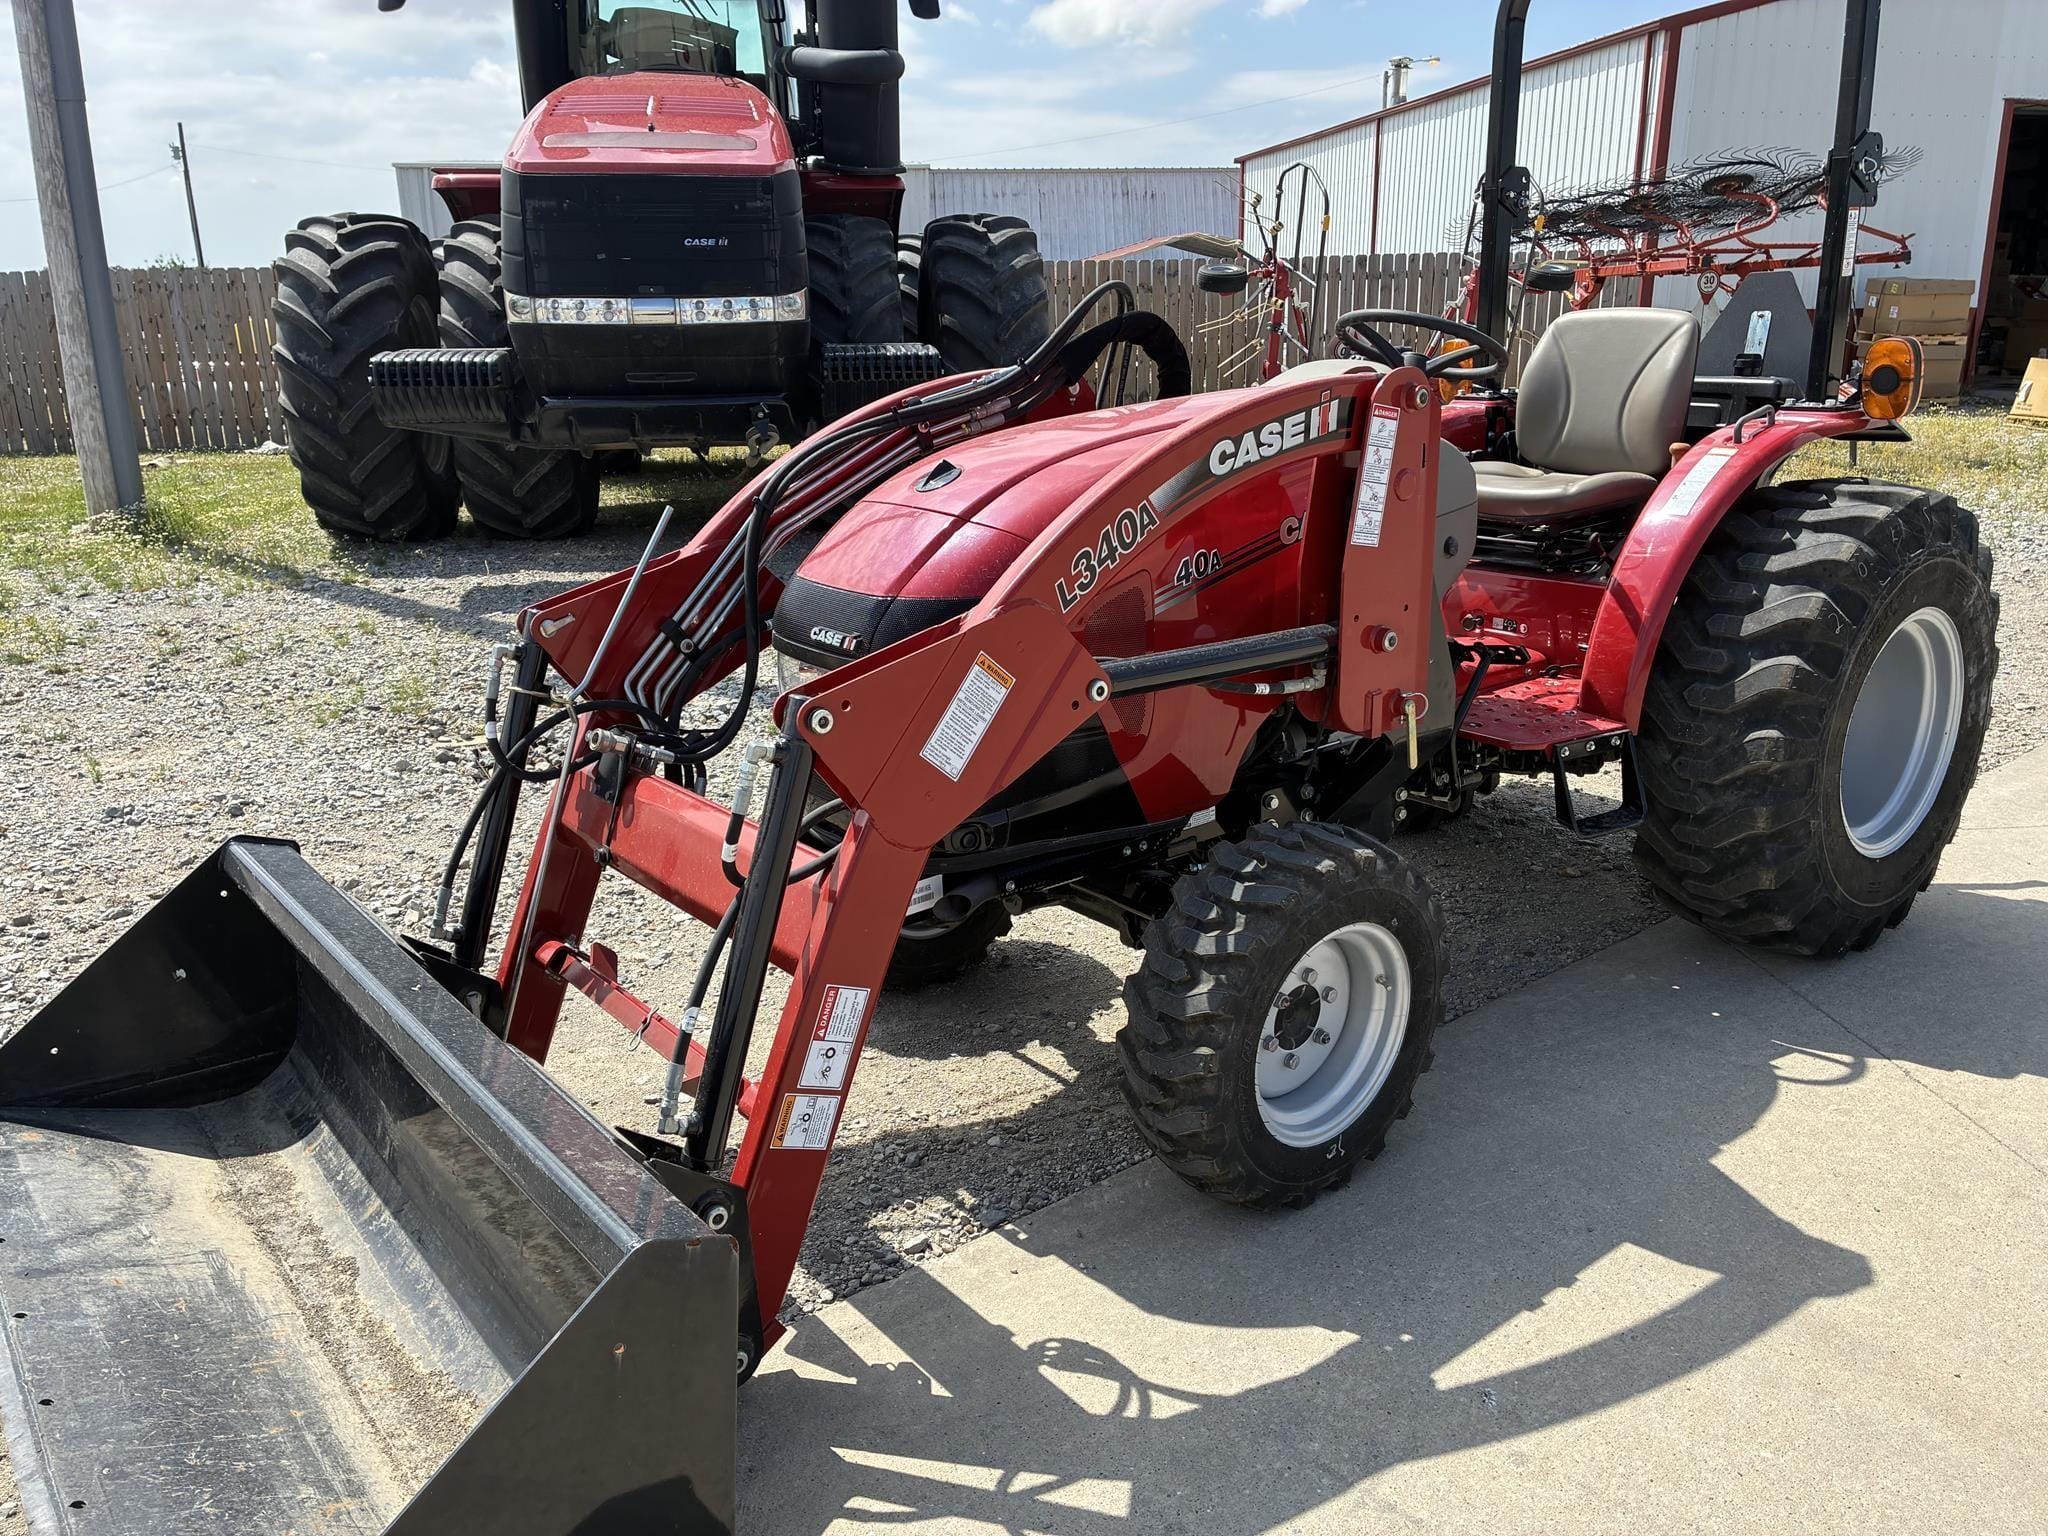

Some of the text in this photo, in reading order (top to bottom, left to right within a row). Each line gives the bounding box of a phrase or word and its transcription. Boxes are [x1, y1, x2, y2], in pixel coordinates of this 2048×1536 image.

[684, 238, 716, 246] CASE
[1703, 275, 1715, 285] 30
[1209, 411, 1306, 475] CASE
[1055, 500, 1159, 614] L340A
[1174, 548, 1223, 587] 40A
[810, 627, 844, 647] CASE
[986, 664, 1009, 685] WARNING
[821, 990, 836, 1026] DANGER
[779, 1101, 792, 1132] WARNING
